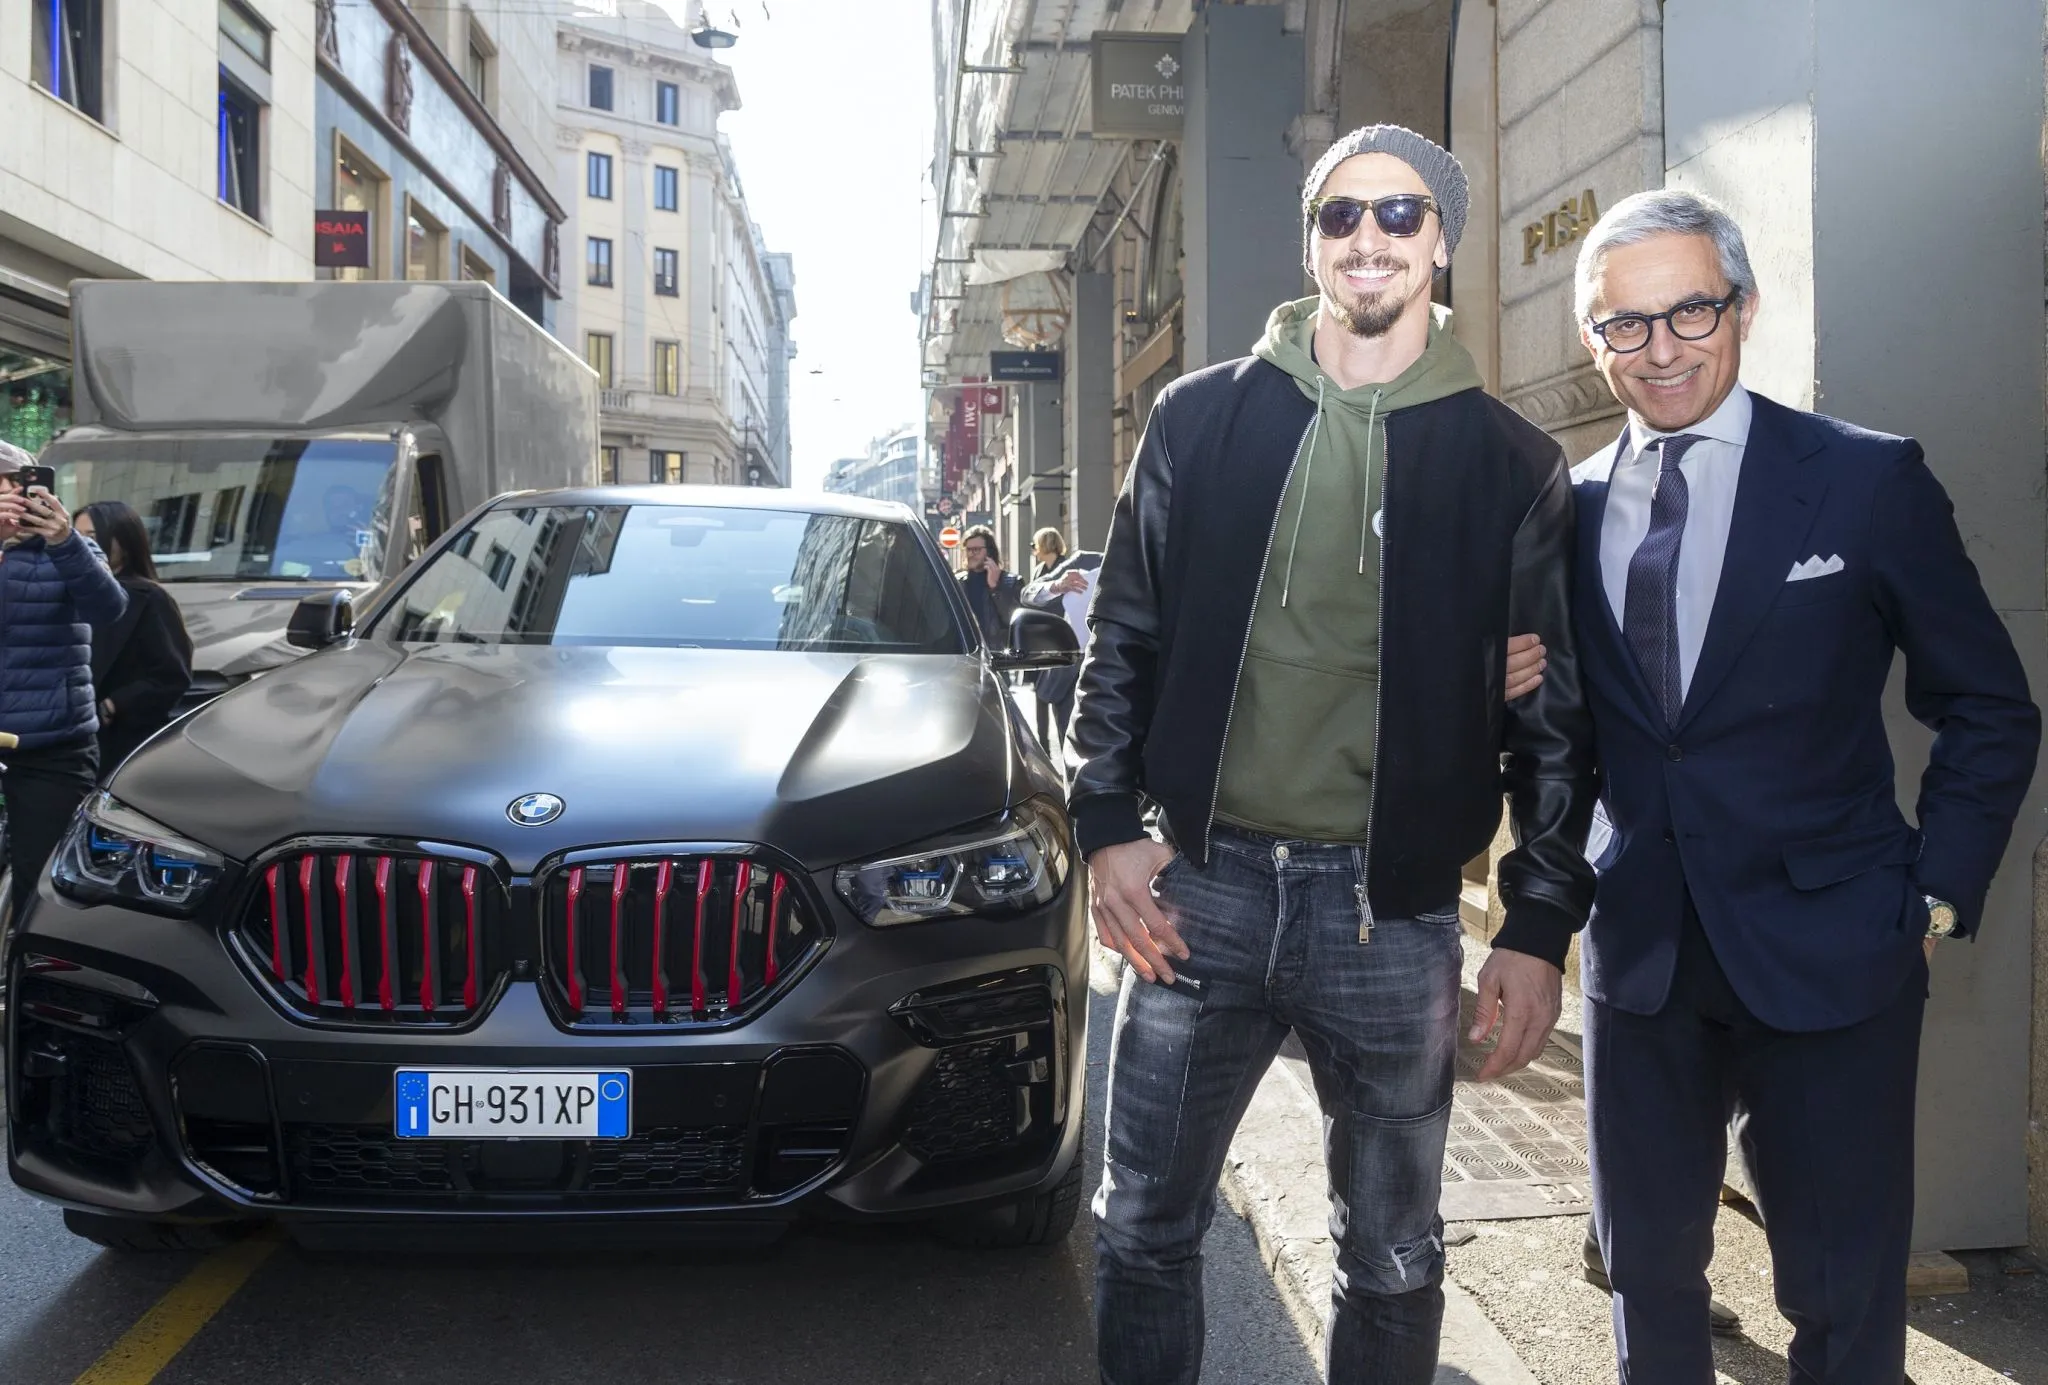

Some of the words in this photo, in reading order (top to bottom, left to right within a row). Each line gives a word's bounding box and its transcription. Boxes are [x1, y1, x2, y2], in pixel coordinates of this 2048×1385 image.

[1111, 83, 1156, 99] PATEK
[1160, 84, 1184, 100] PHI
[1520, 189, 1599, 265] PISA
[964, 401, 976, 428] IWC
